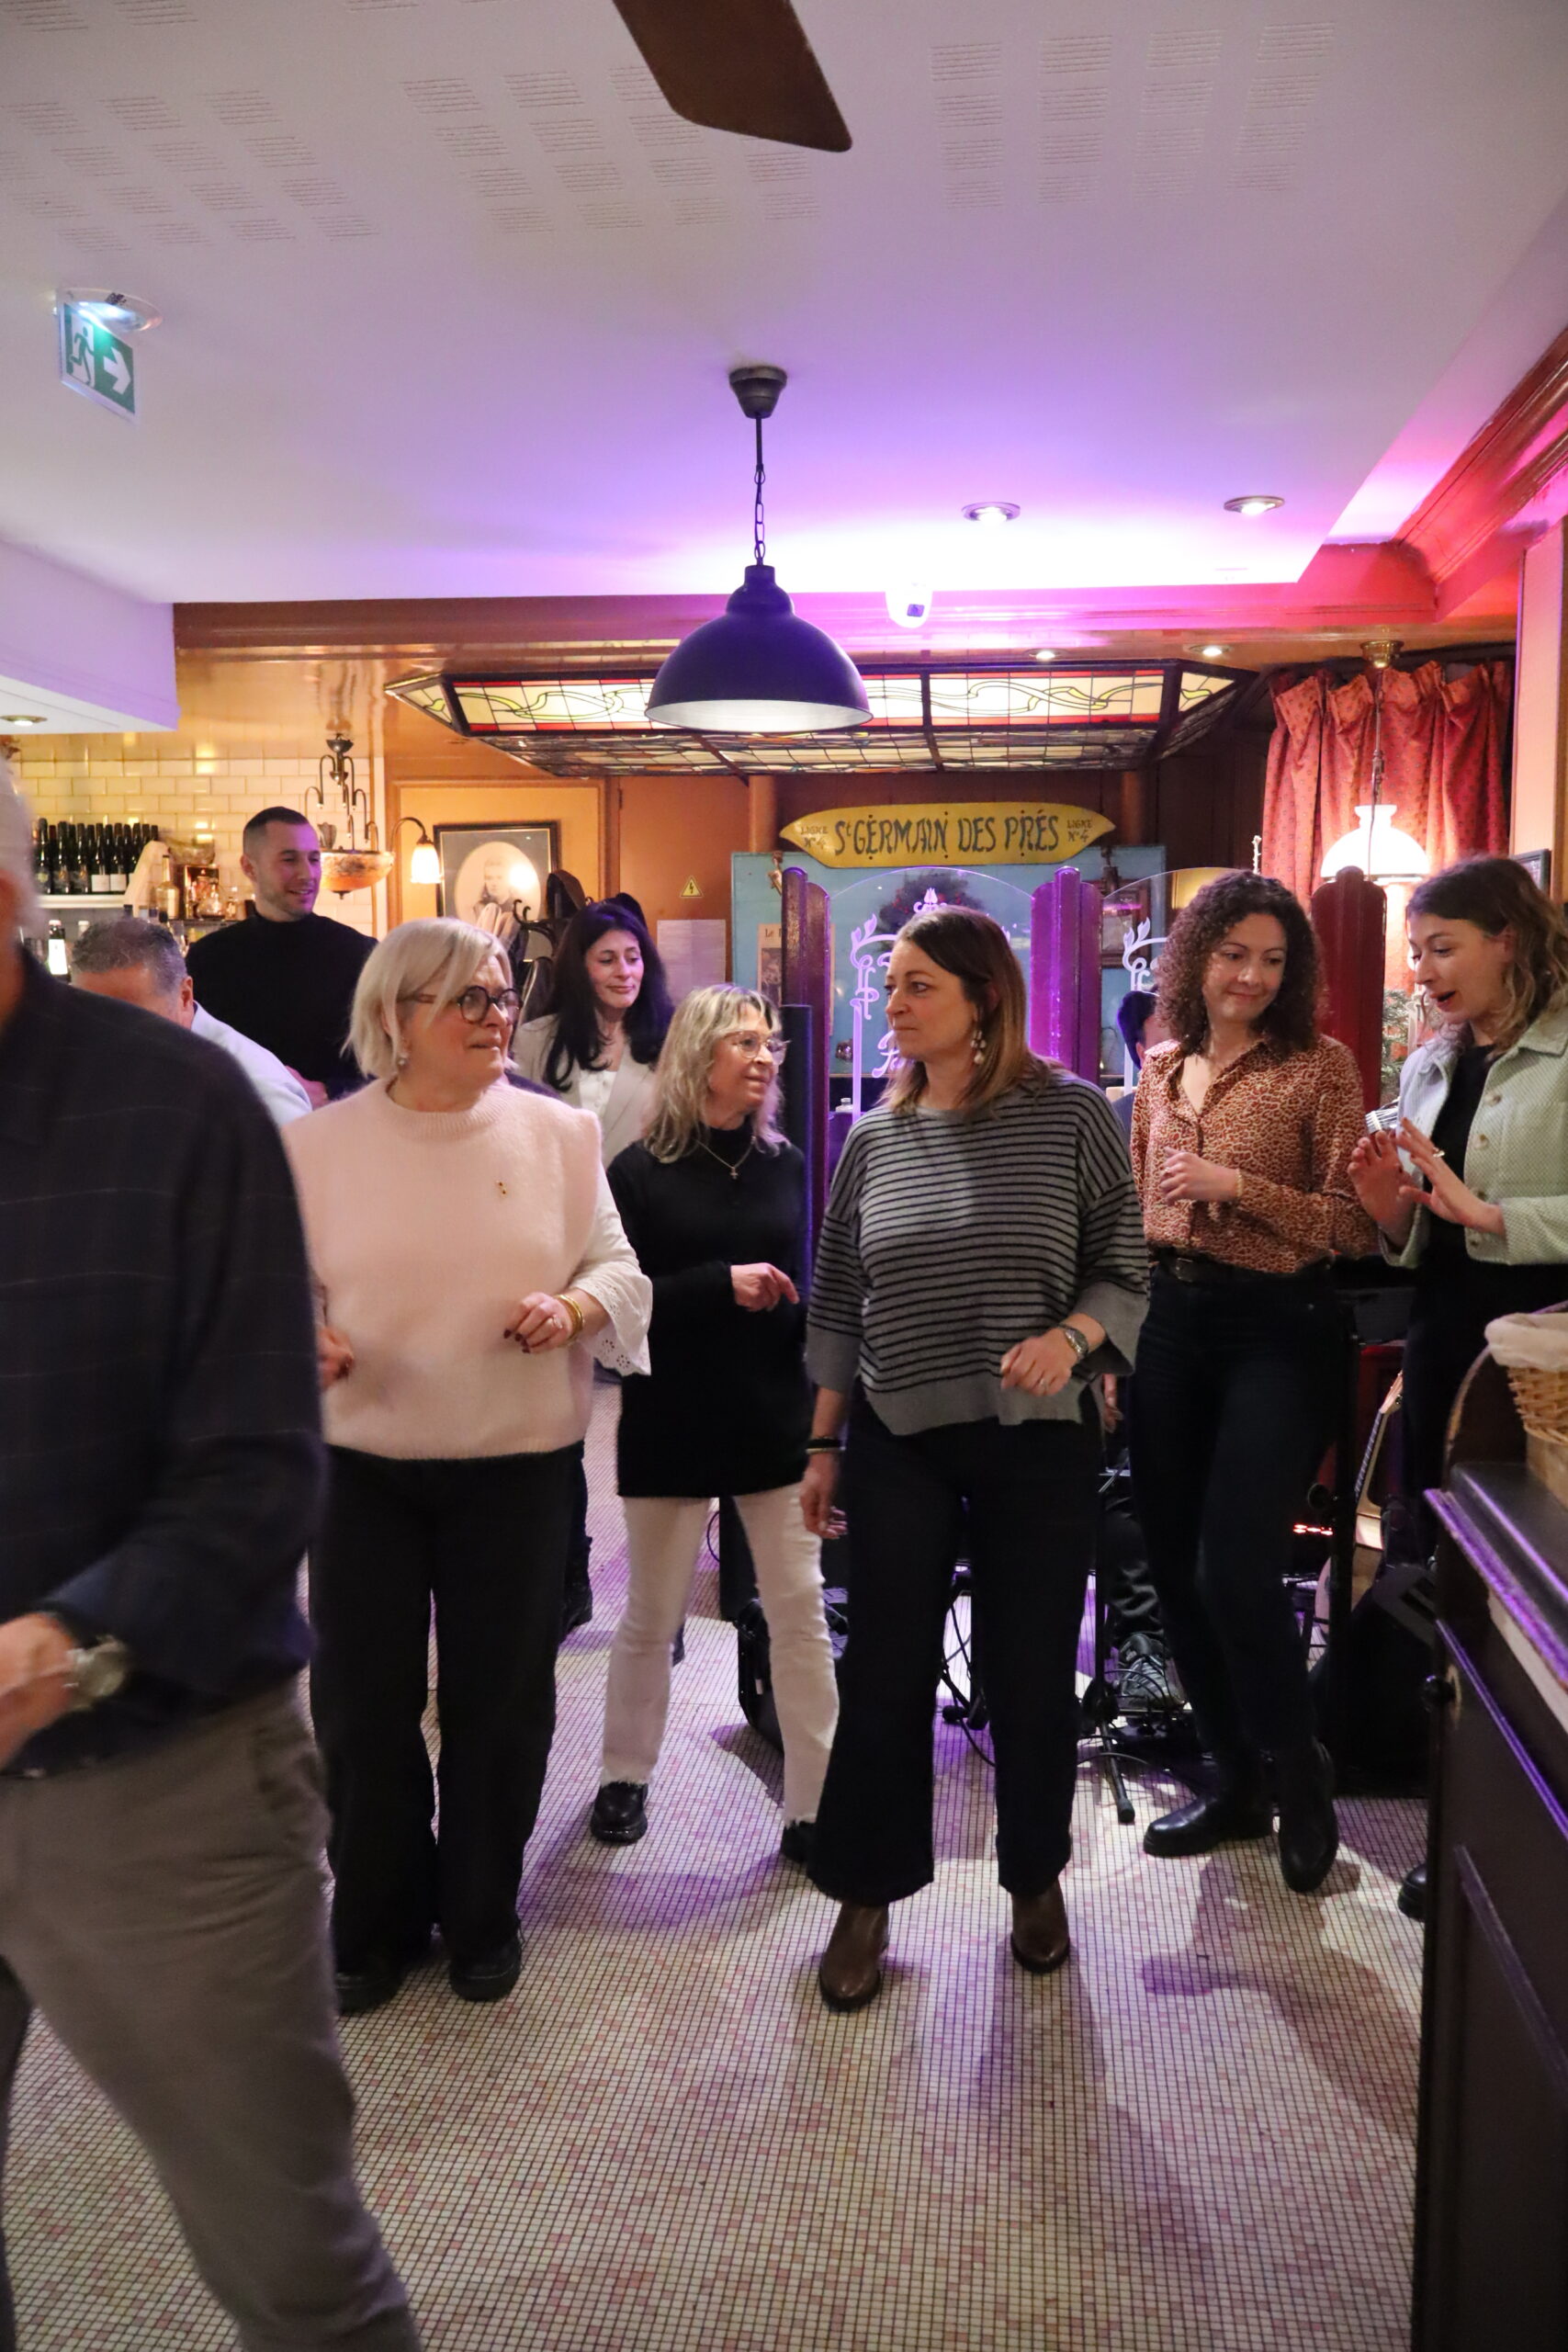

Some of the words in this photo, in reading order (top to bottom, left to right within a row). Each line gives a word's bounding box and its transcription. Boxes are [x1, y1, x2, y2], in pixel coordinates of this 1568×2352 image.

[853, 818, 948, 854] GERMAIN
[958, 817, 996, 853] DES
[1005, 808, 1059, 851] PRÉS
